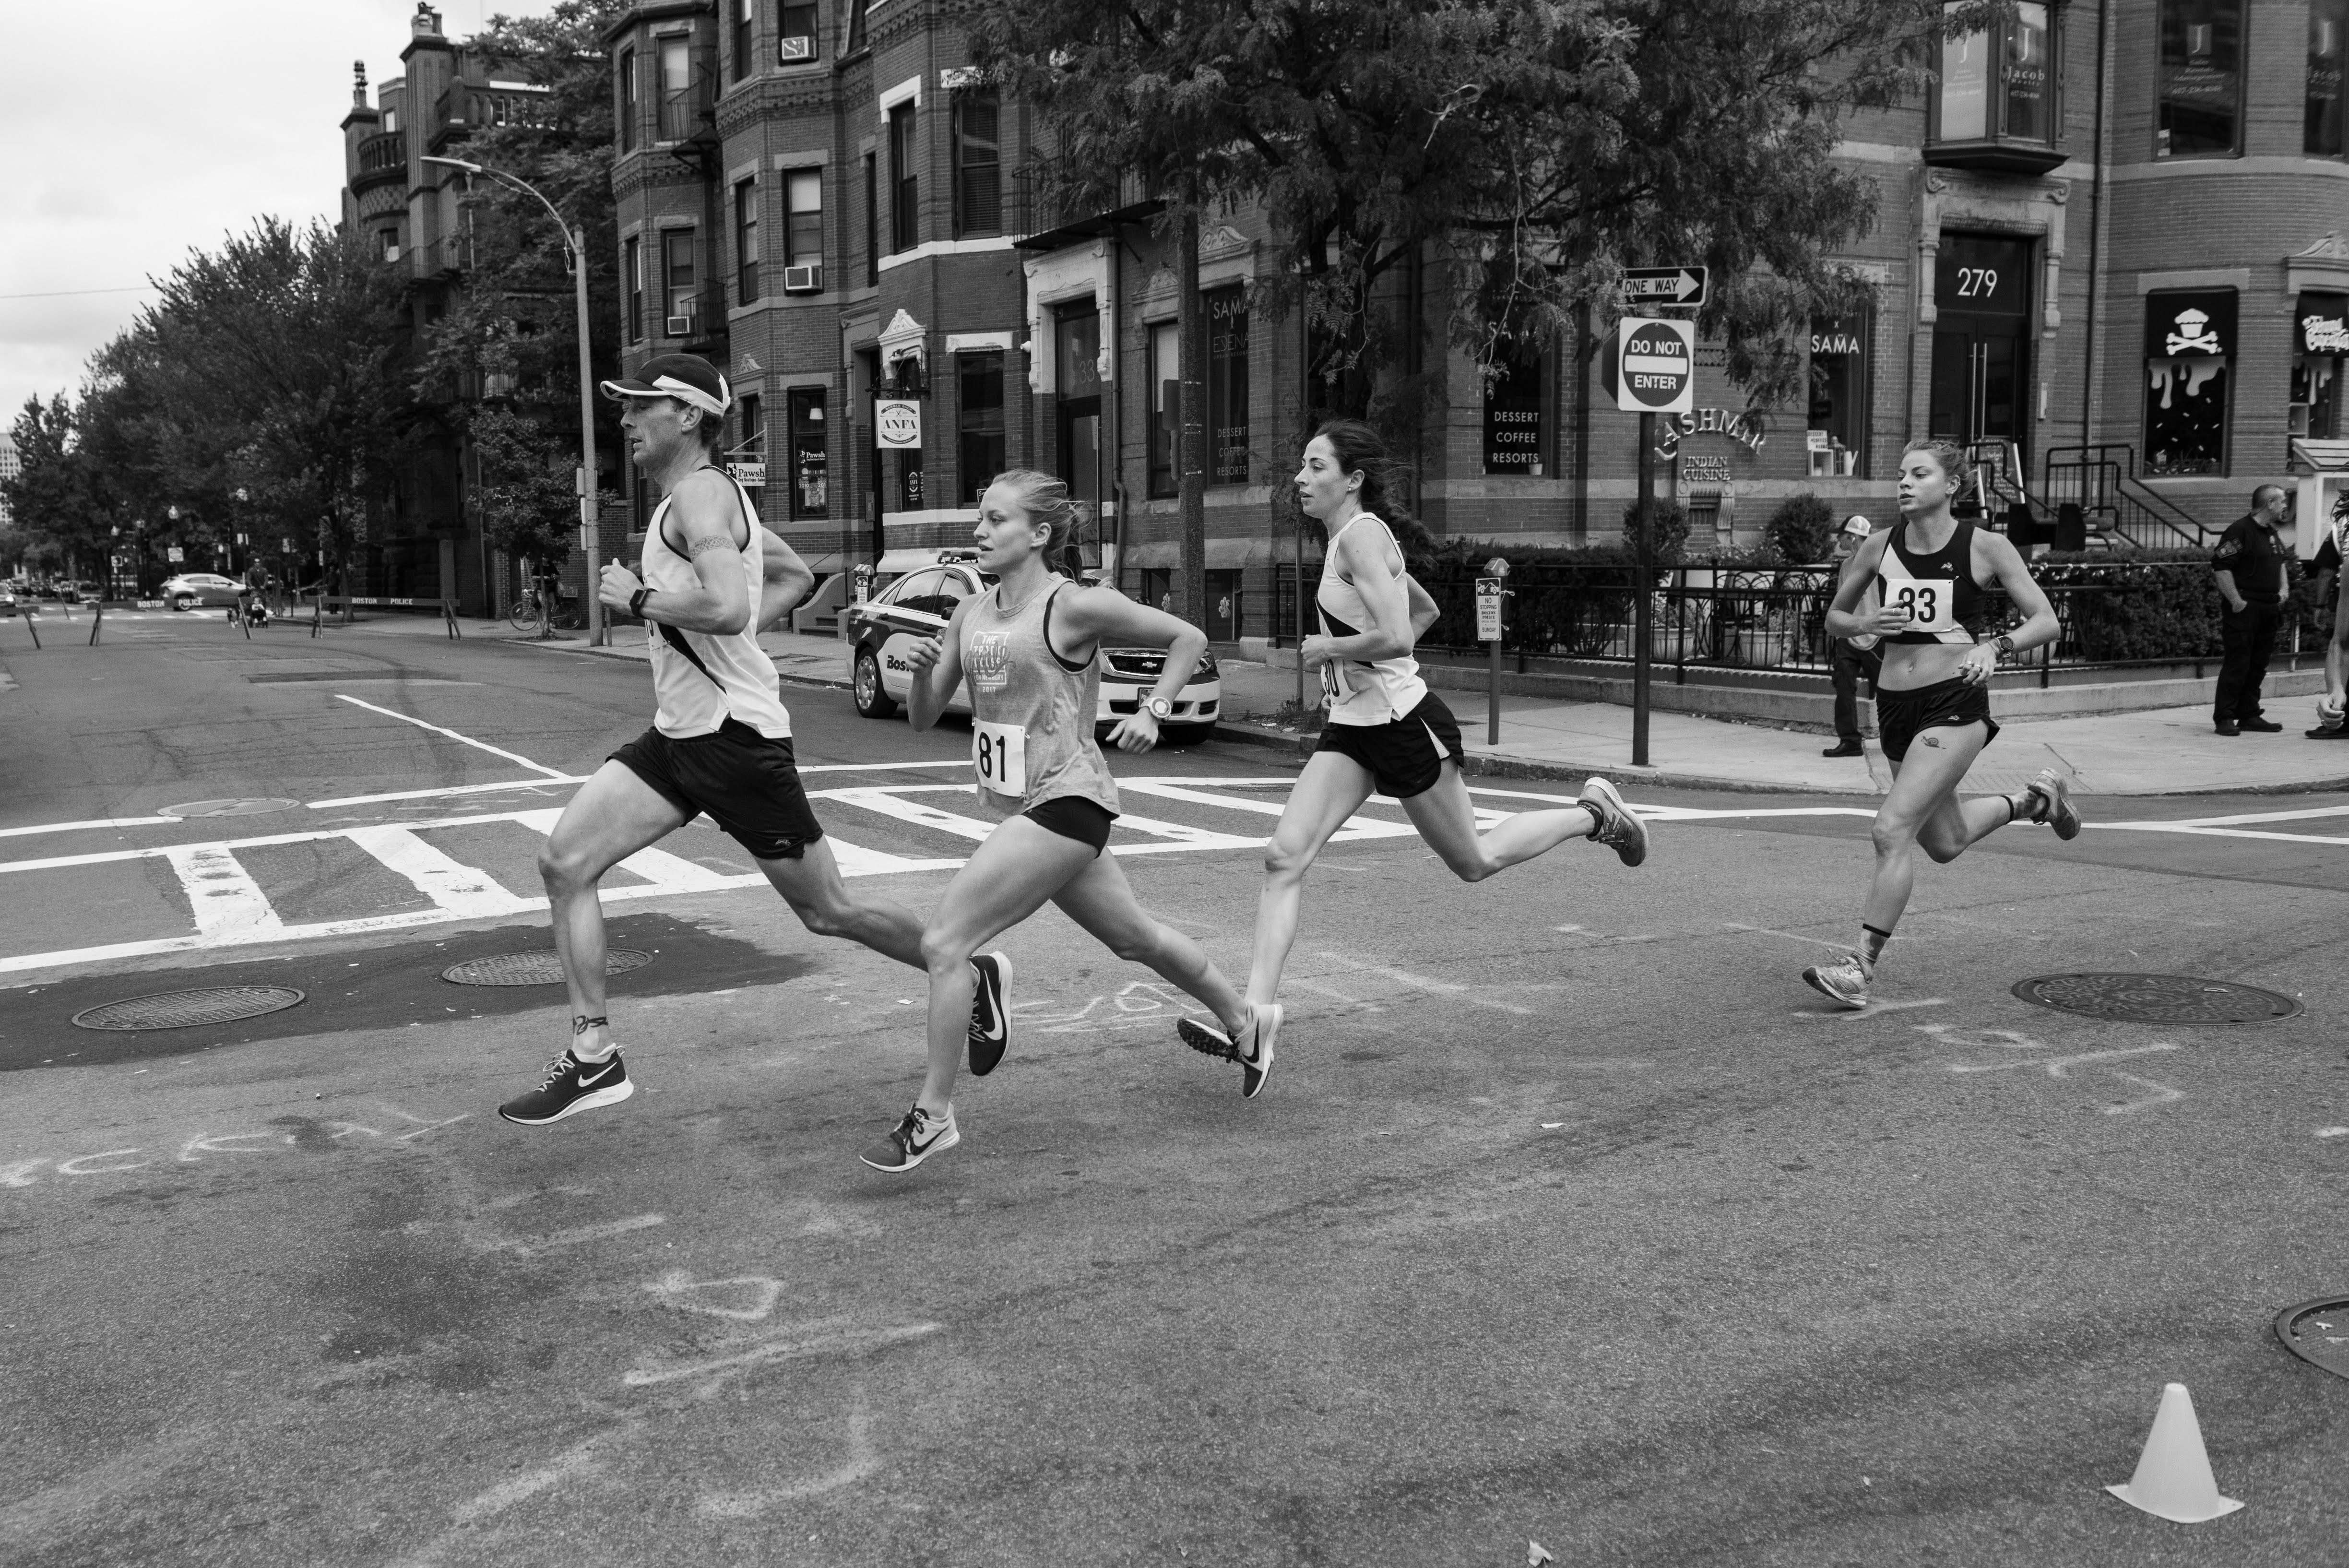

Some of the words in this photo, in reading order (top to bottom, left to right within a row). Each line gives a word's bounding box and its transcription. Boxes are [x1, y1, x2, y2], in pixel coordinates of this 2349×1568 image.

[2008, 66, 2045, 81] Jacob
[1625, 280, 1648, 293] ONE
[1655, 279, 1679, 293] WAY
[1958, 267, 1997, 297] 279
[1631, 339, 1651, 354] DO
[1655, 341, 1682, 356] NOT
[1811, 333, 1860, 354] SAMA
[1634, 374, 1677, 390] ENTER
[1495, 412, 1539, 422] DESSERT
[883, 419, 916, 429] ANFA
[1218, 427, 1246, 438] DESSERT
[1496, 432, 1536, 443] COFFEE
[1493, 452, 1539, 463] RESORTS
[1685, 456, 1728, 468] INDIAN
[738, 468, 765, 477] Pawsh
[1217, 465, 1247, 476] RESORTS
[1683, 469, 1730, 480] CUISINE
[1898, 587, 1936, 623] 83
[982, 635, 998, 644] THE
[978, 731, 1006, 783] 81
